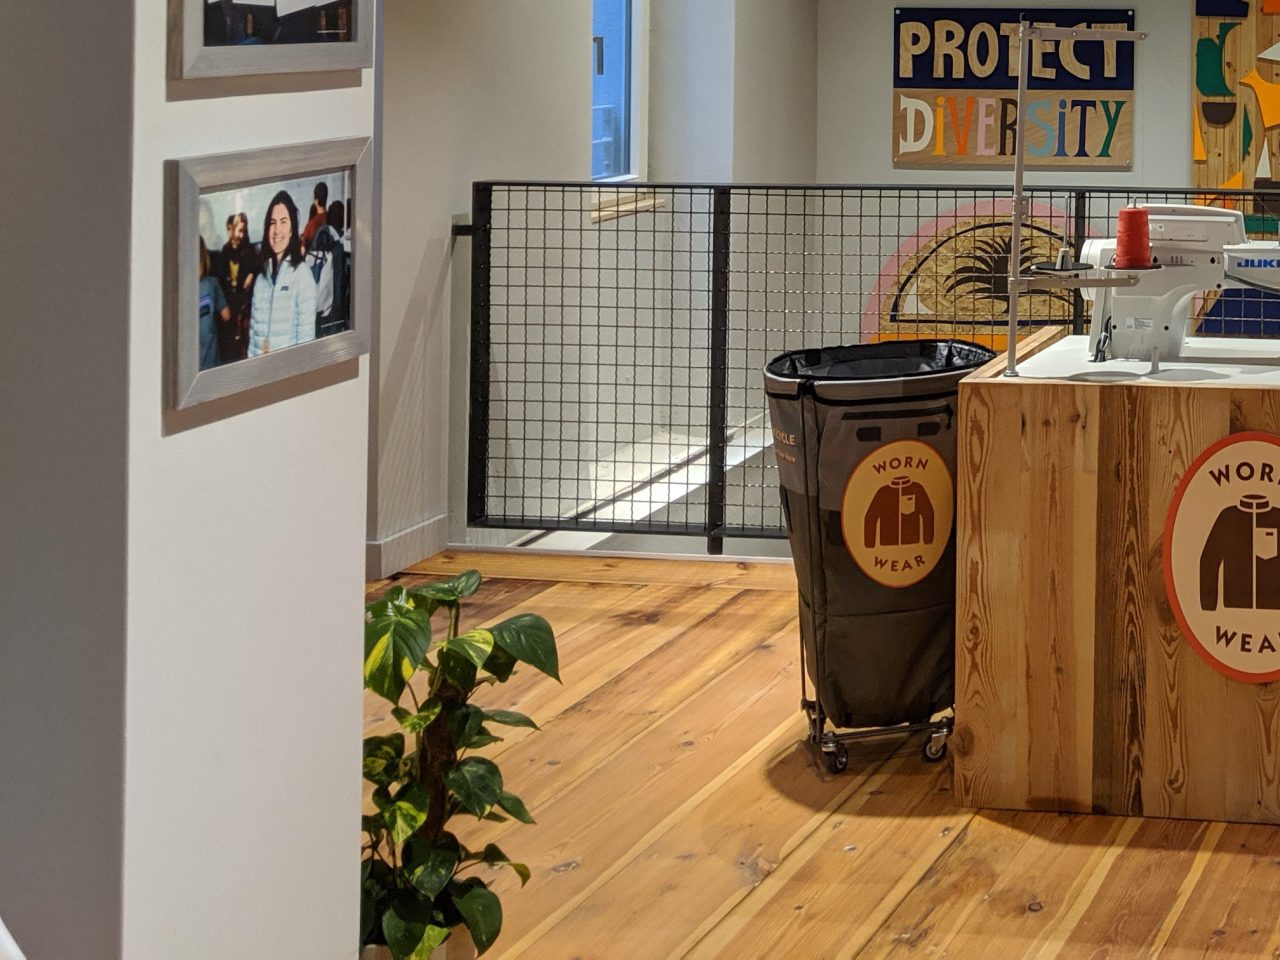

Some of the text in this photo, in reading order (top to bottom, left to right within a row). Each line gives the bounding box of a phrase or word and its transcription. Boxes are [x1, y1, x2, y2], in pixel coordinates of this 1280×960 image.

[898, 19, 1128, 81] PROTECT
[1236, 258, 1280, 268] JUKI
[872, 455, 929, 475] WORN
[873, 554, 926, 572] WEAR
